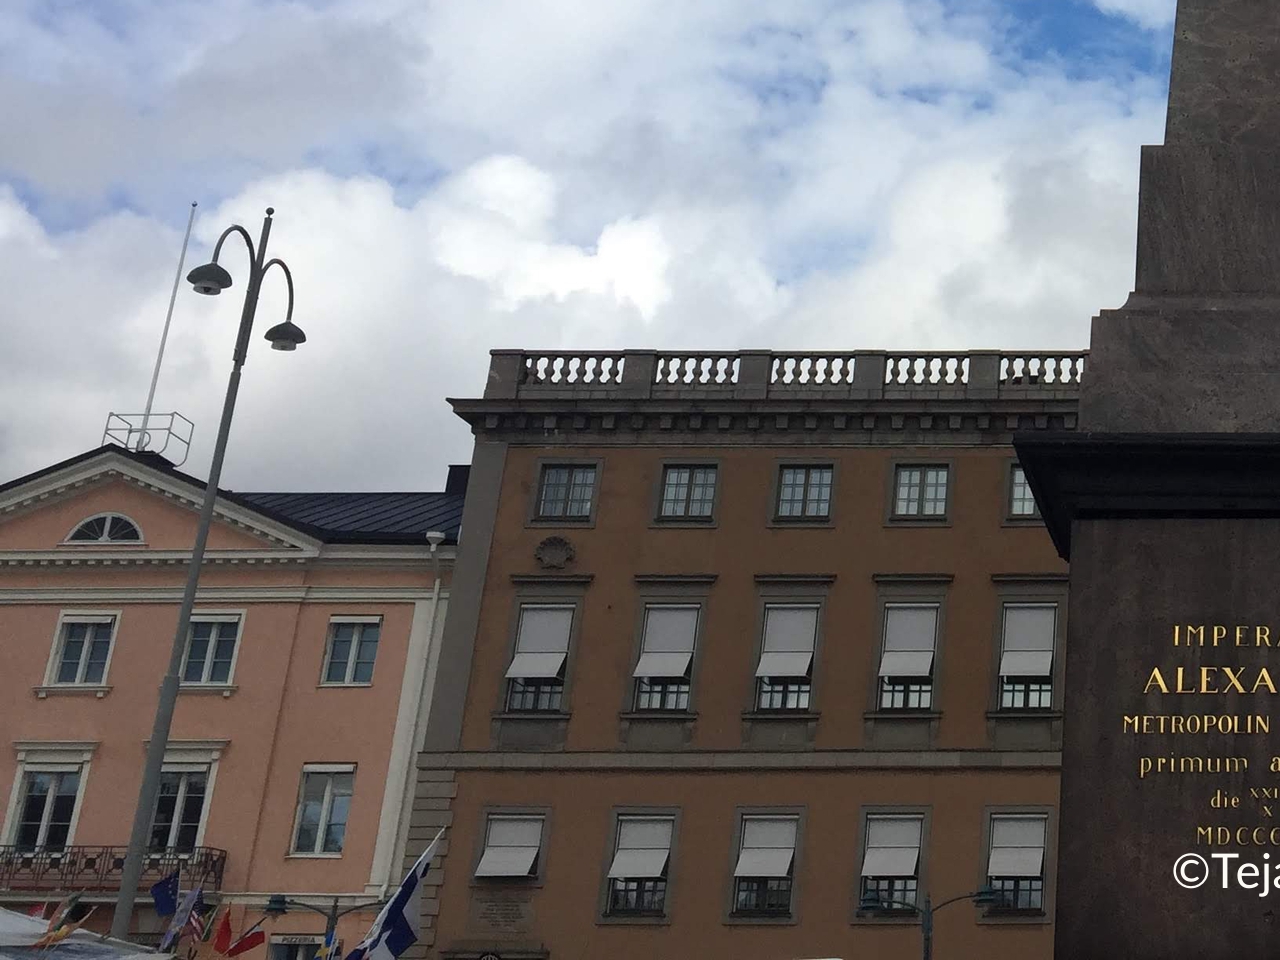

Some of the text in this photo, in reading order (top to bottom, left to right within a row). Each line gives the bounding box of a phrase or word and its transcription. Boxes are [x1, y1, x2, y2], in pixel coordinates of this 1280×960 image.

[1122, 714, 1271, 735] METROPOLIN
[1138, 753, 1249, 779] primum
[1210, 789, 1241, 809] die
